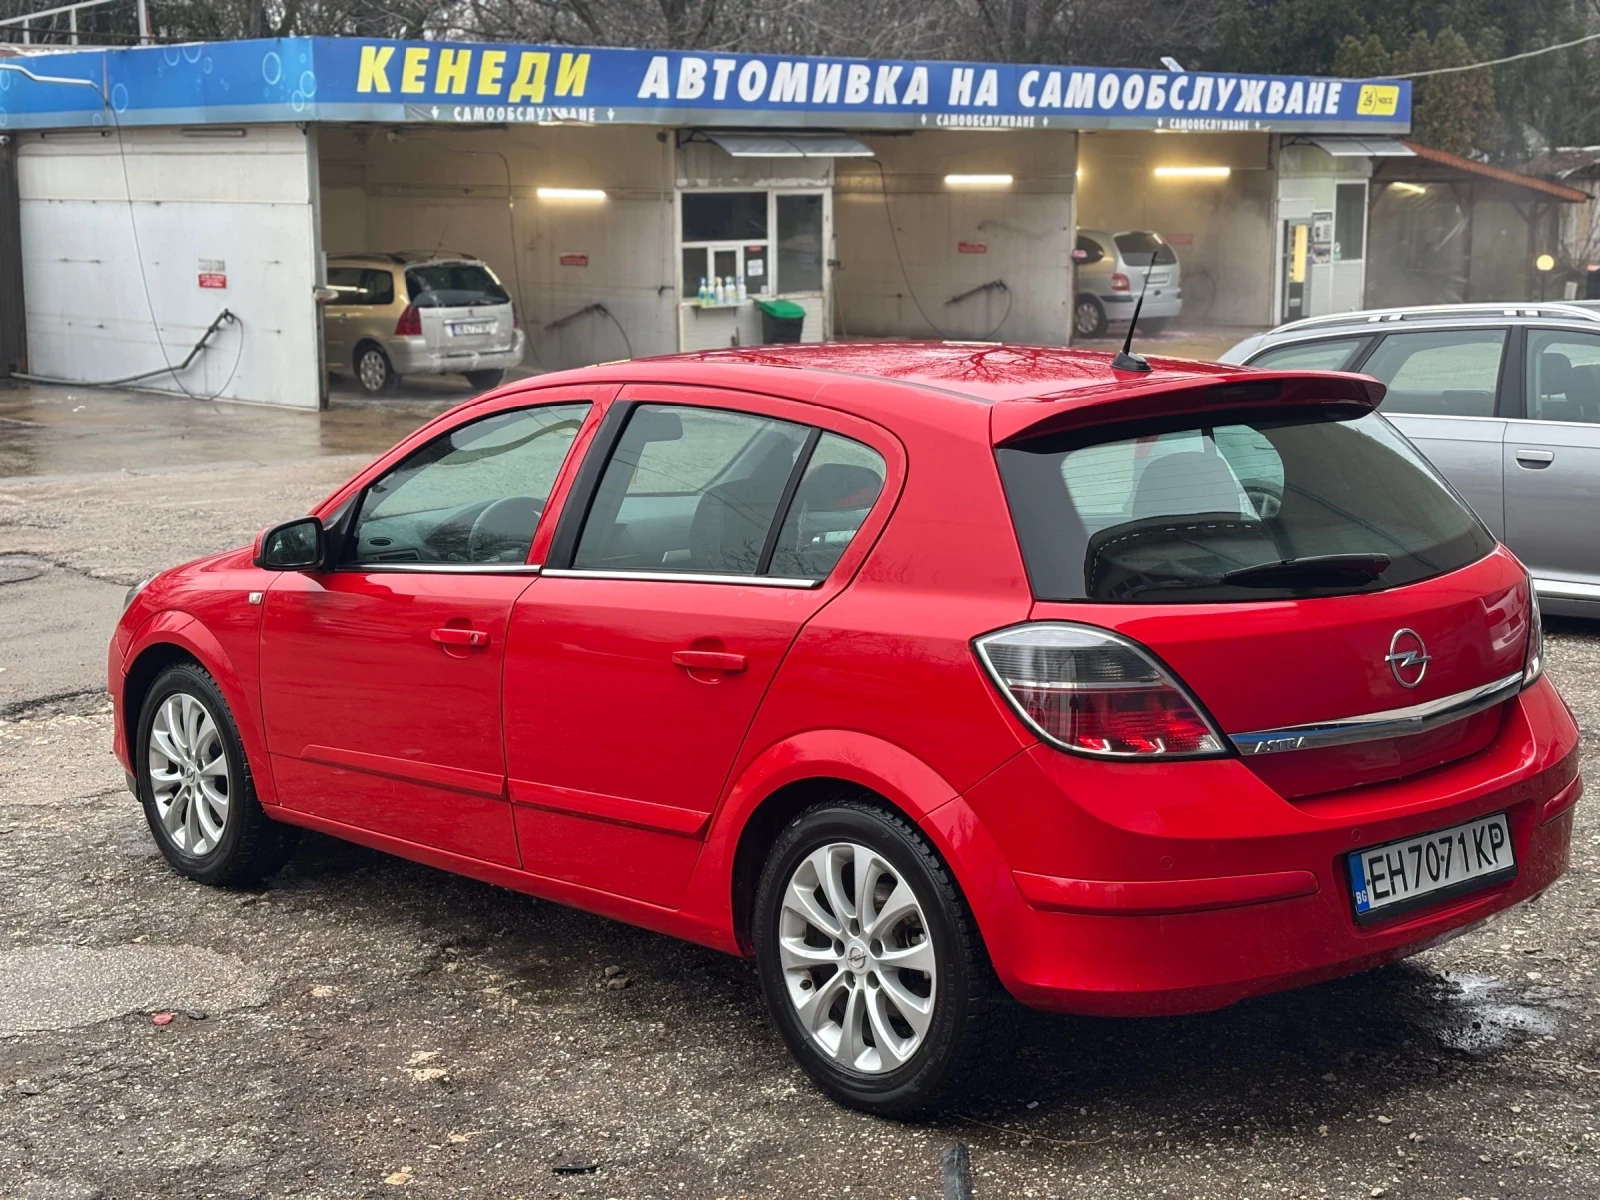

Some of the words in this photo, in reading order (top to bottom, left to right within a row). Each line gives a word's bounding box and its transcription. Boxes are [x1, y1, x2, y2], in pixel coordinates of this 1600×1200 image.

[356, 45, 591, 103] КЕНЕДИ
[637, 56, 929, 106] АВТОМИВКА
[948, 67, 999, 107] НА
[1018, 69, 1343, 115] САМООБСЛУЖВАНЕ
[936, 113, 1035, 128] САМООБСЛУЖВАНЕ
[1169, 117, 1250, 131] САМООБСЛУЖВАНЕ
[1254, 736, 1308, 753] ASTRA
[1355, 889, 1368, 905] BG
